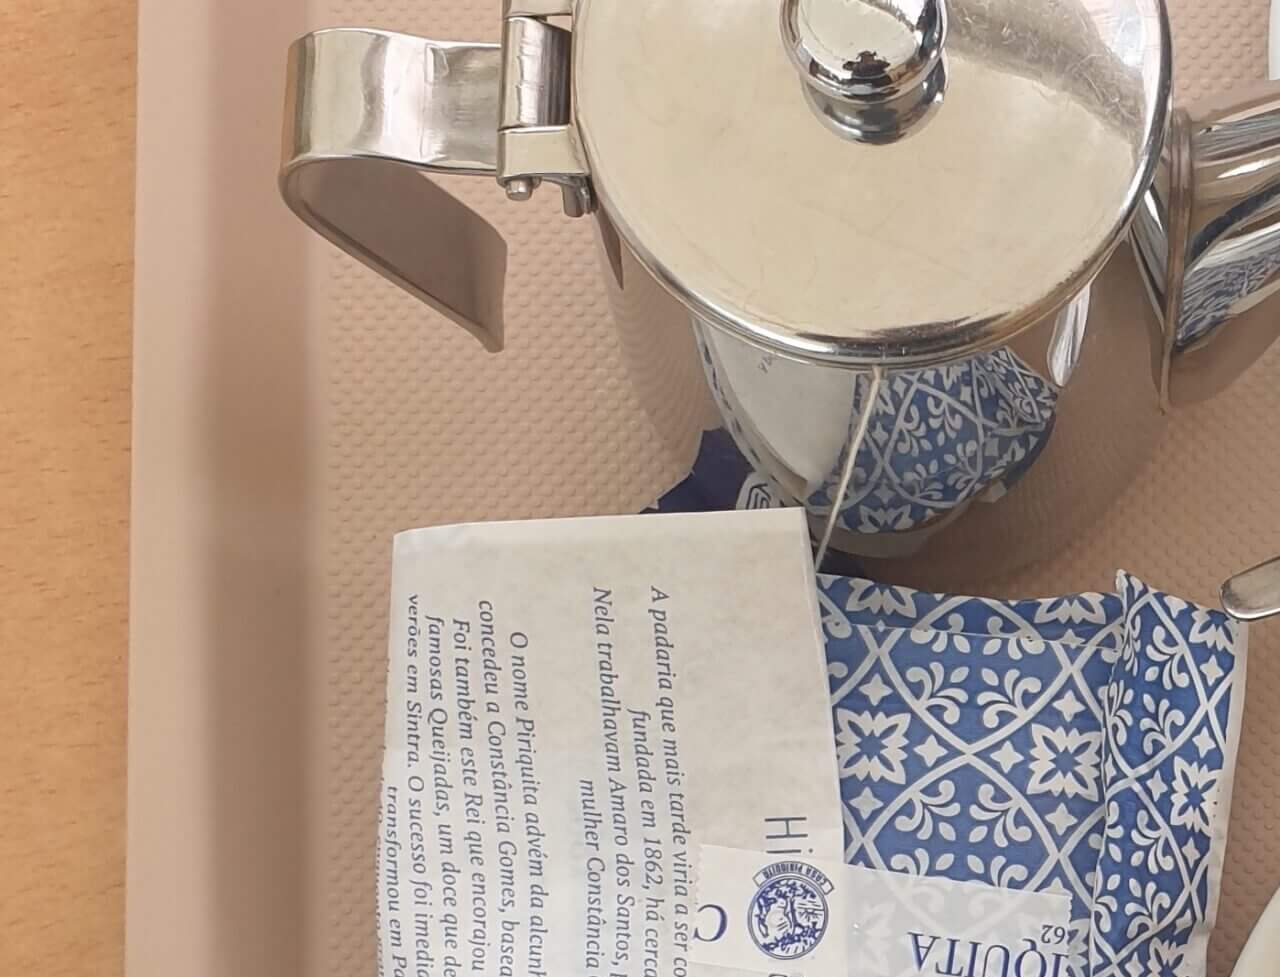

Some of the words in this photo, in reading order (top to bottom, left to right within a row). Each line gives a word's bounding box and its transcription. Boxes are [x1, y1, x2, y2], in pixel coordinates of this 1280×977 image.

[593, 587, 614, 635] Nela
[651, 586, 669, 602] A
[408, 595, 420, 657] verões
[453, 619, 472, 650] Foi
[479, 601, 502, 694] concedeu
[510, 632, 528, 648] O
[648, 609, 676, 689] padaria
[407, 665, 417, 693] em
[425, 616, 445, 700] famosas
[455, 658, 478, 739] também
[486, 702, 499, 712] a
[512, 656, 528, 711] nome
[597, 643, 622, 772] trabalhavam
[407, 700, 422, 767] Sintra.
[656, 697, 675, 732] que
[427, 708, 453, 816] Queijadas,
[460, 747, 477, 786] este
[515, 717, 540, 805] Piriquita
[627, 709, 656, 792] fundada
[663, 739, 685, 786] mais
[408, 776, 424, 792] O
[488, 721, 515, 832] Constância
[464, 792, 485, 824] Rei
[580, 780, 603, 851] mulher
[608, 776, 628, 847] Amaro
[641, 800, 656, 827] em
[669, 793, 691, 845] tarde
[386, 787, 402, 911] transformou
[409, 798, 426, 874] sucesso
[438, 824, 453, 854] um
[464, 831, 484, 866] que
[525, 813, 548, 876] advém
[441, 862, 461, 907] doce
[498, 841, 517, 912] Gomes,
[616, 854, 635, 887] dos
[642, 838, 663, 889] 1862,
[673, 851, 693, 896] viria
[409, 880, 432, 906] foi
[530, 884, 549, 908] da
[586, 857, 607, 968] Constância
[646, 897, 665, 921] há
[675, 904, 688, 915] a
[390, 919, 402, 947] em
[439, 914, 457, 949] que
[468, 873, 490, 970] encorajou
[611, 894, 635, 965] Santos,
[674, 922, 688, 952] ser
